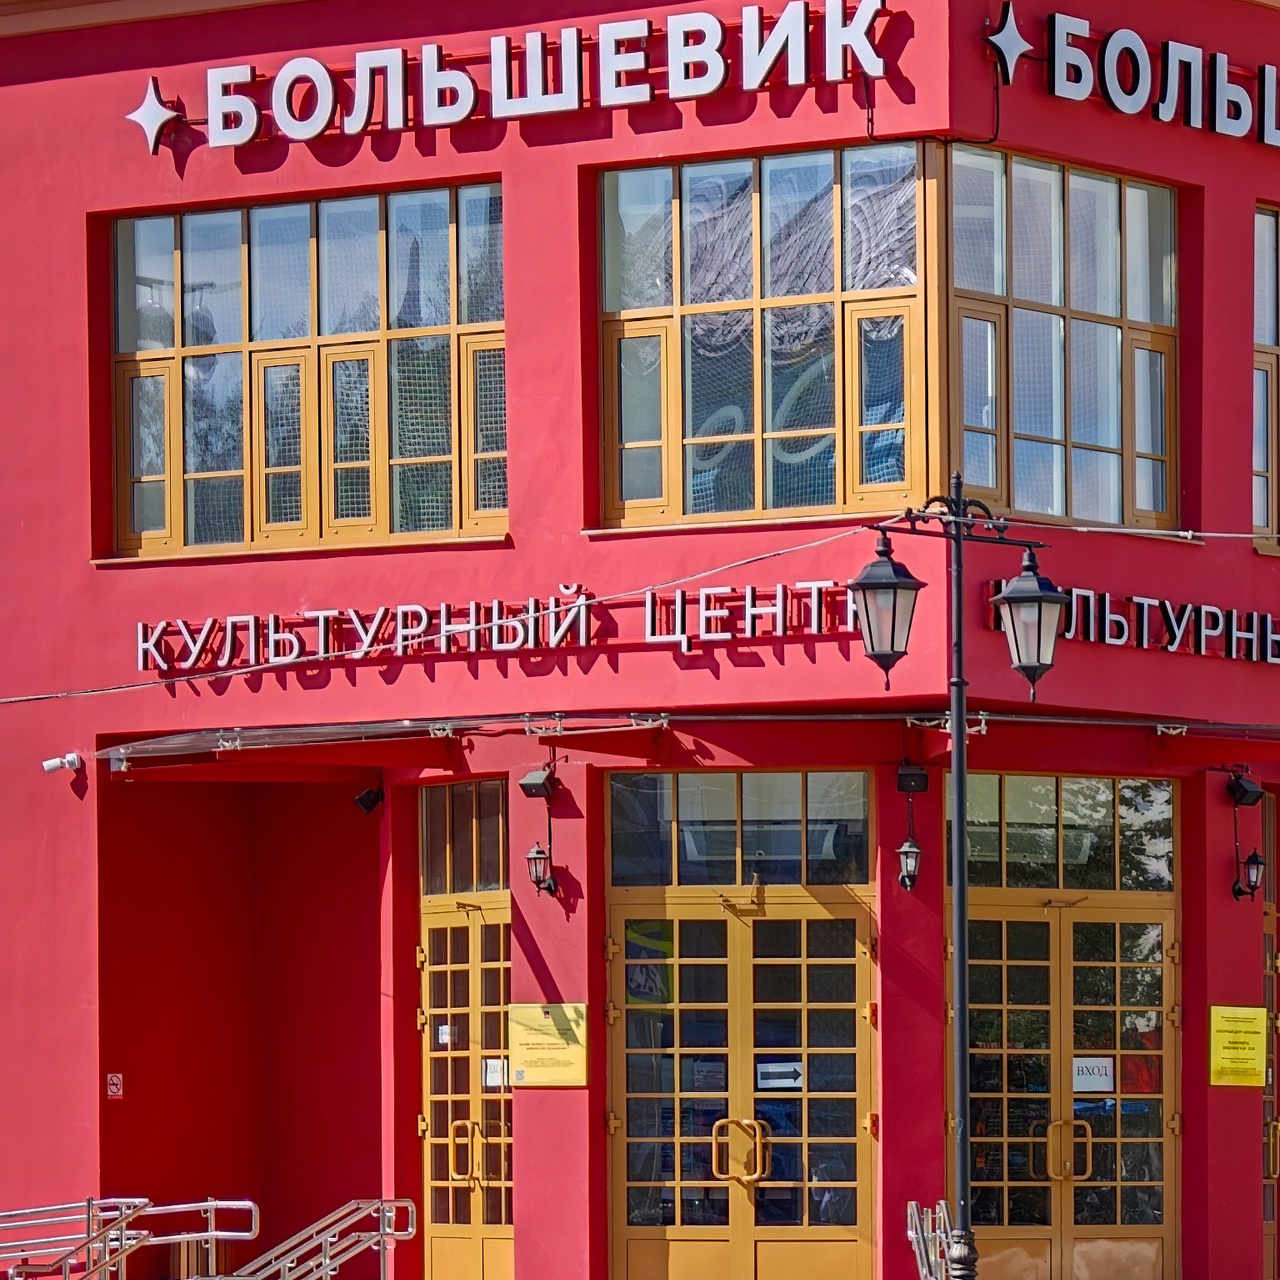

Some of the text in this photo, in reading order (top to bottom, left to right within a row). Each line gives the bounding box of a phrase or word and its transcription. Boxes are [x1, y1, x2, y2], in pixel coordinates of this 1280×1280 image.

[206, 0, 885, 148] БОЛЬШЕВИК
[137, 584, 591, 671] КУЛЬТУРНЫЙ
[1077, 1065, 1108, 1077] ВХОД
